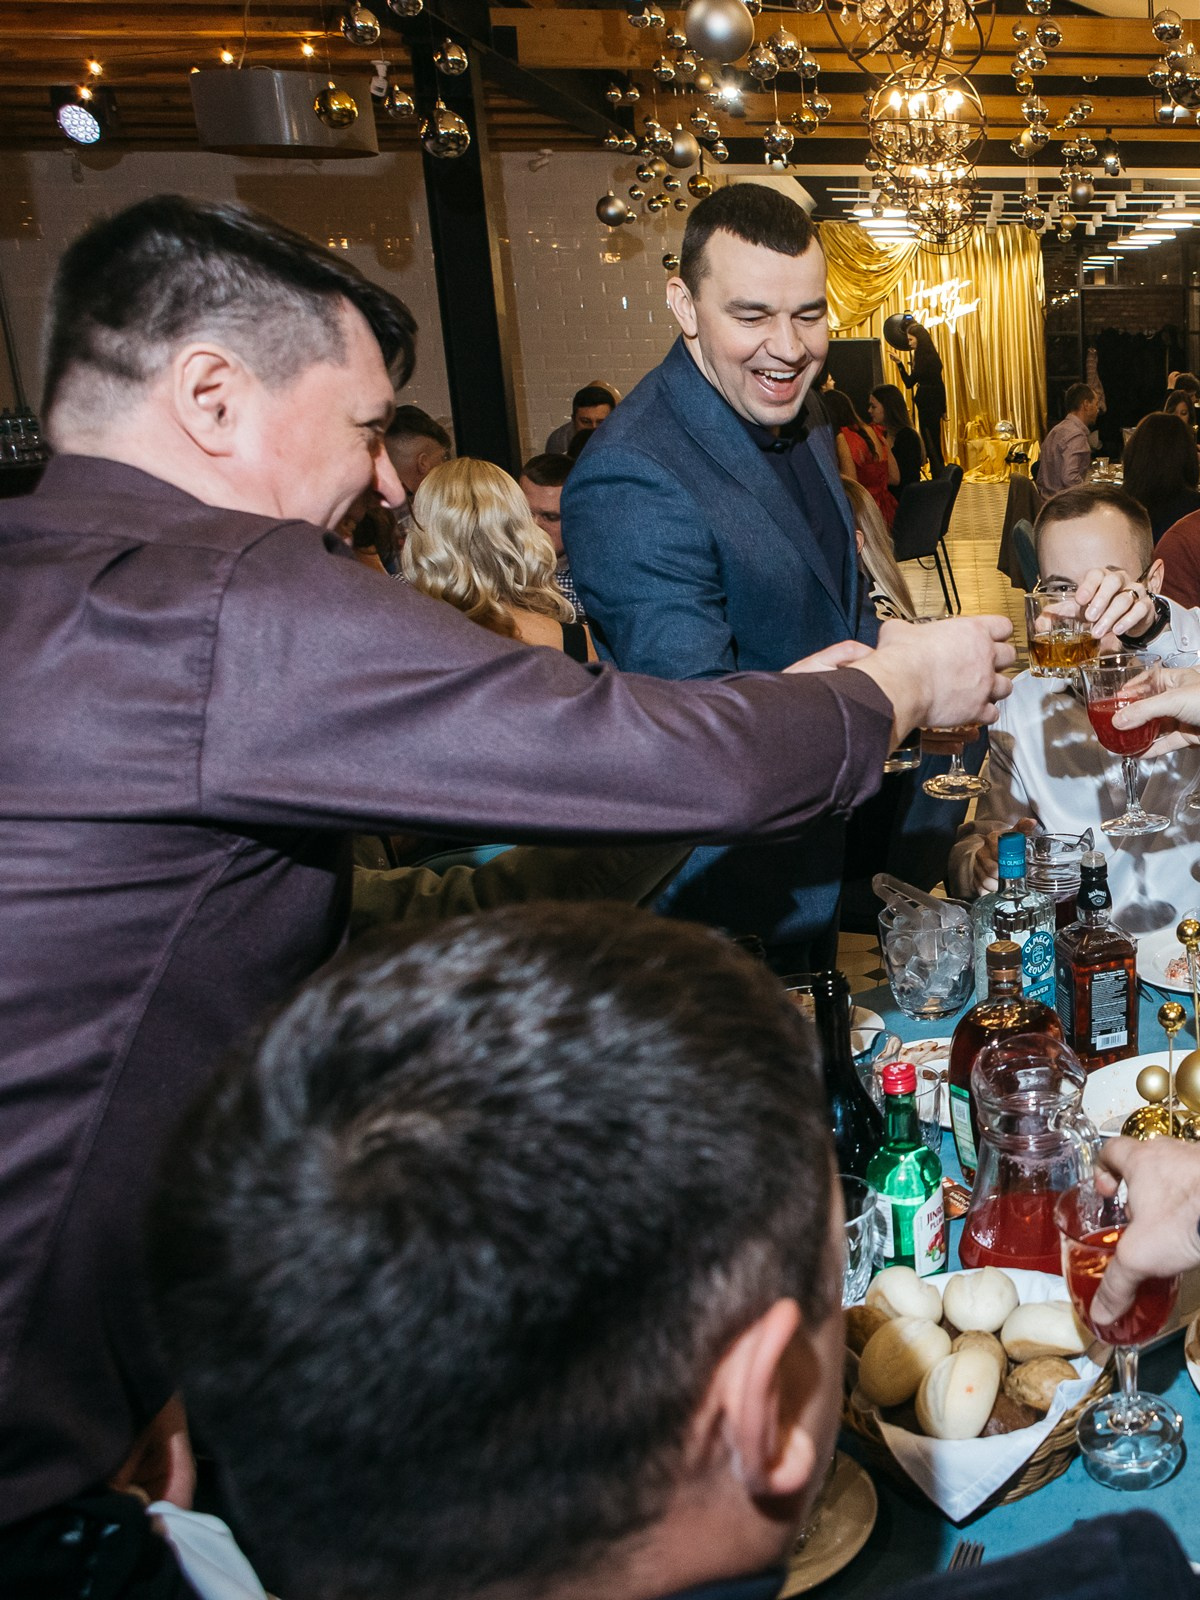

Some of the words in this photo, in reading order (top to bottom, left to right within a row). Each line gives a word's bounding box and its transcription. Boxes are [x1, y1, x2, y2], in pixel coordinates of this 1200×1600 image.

[906, 277, 973, 312] Happy
[1024, 934, 1050, 954] OLMECA
[1025, 955, 1051, 975] TEQUILA
[1028, 985, 1049, 998] SILVER
